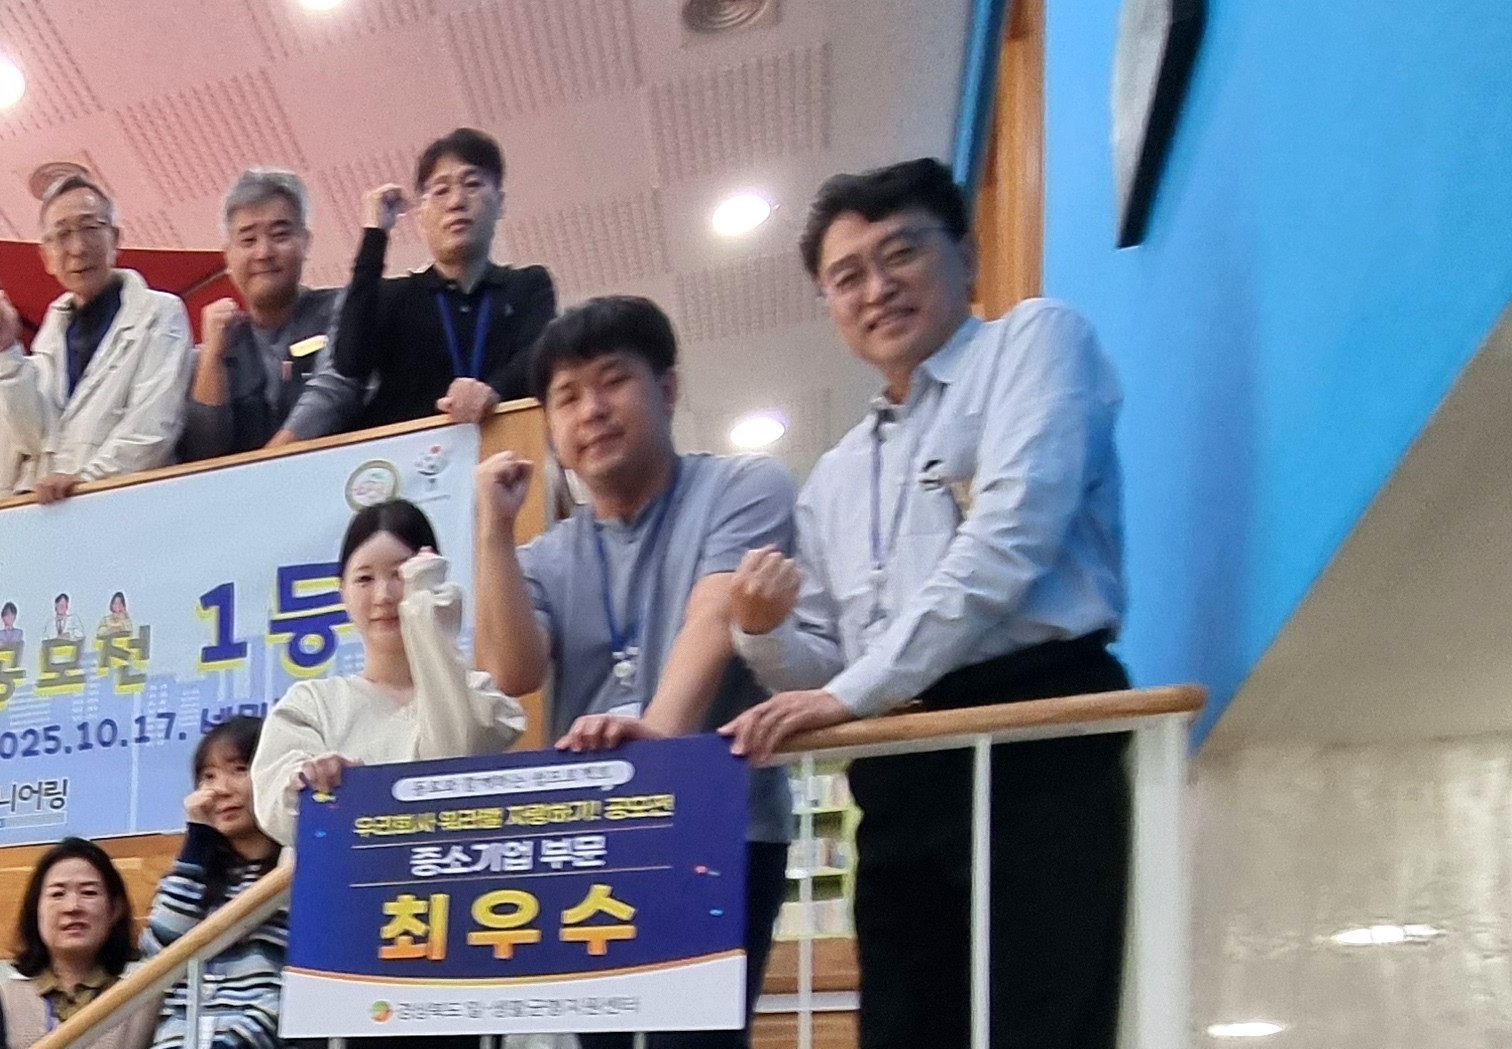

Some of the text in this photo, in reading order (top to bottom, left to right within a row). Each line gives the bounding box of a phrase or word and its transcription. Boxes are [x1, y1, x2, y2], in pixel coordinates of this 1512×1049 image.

[199, 562, 350, 669] 1등
[409, 835, 608, 877] 중소기업 부문
[378, 883, 638, 961] 최우수
